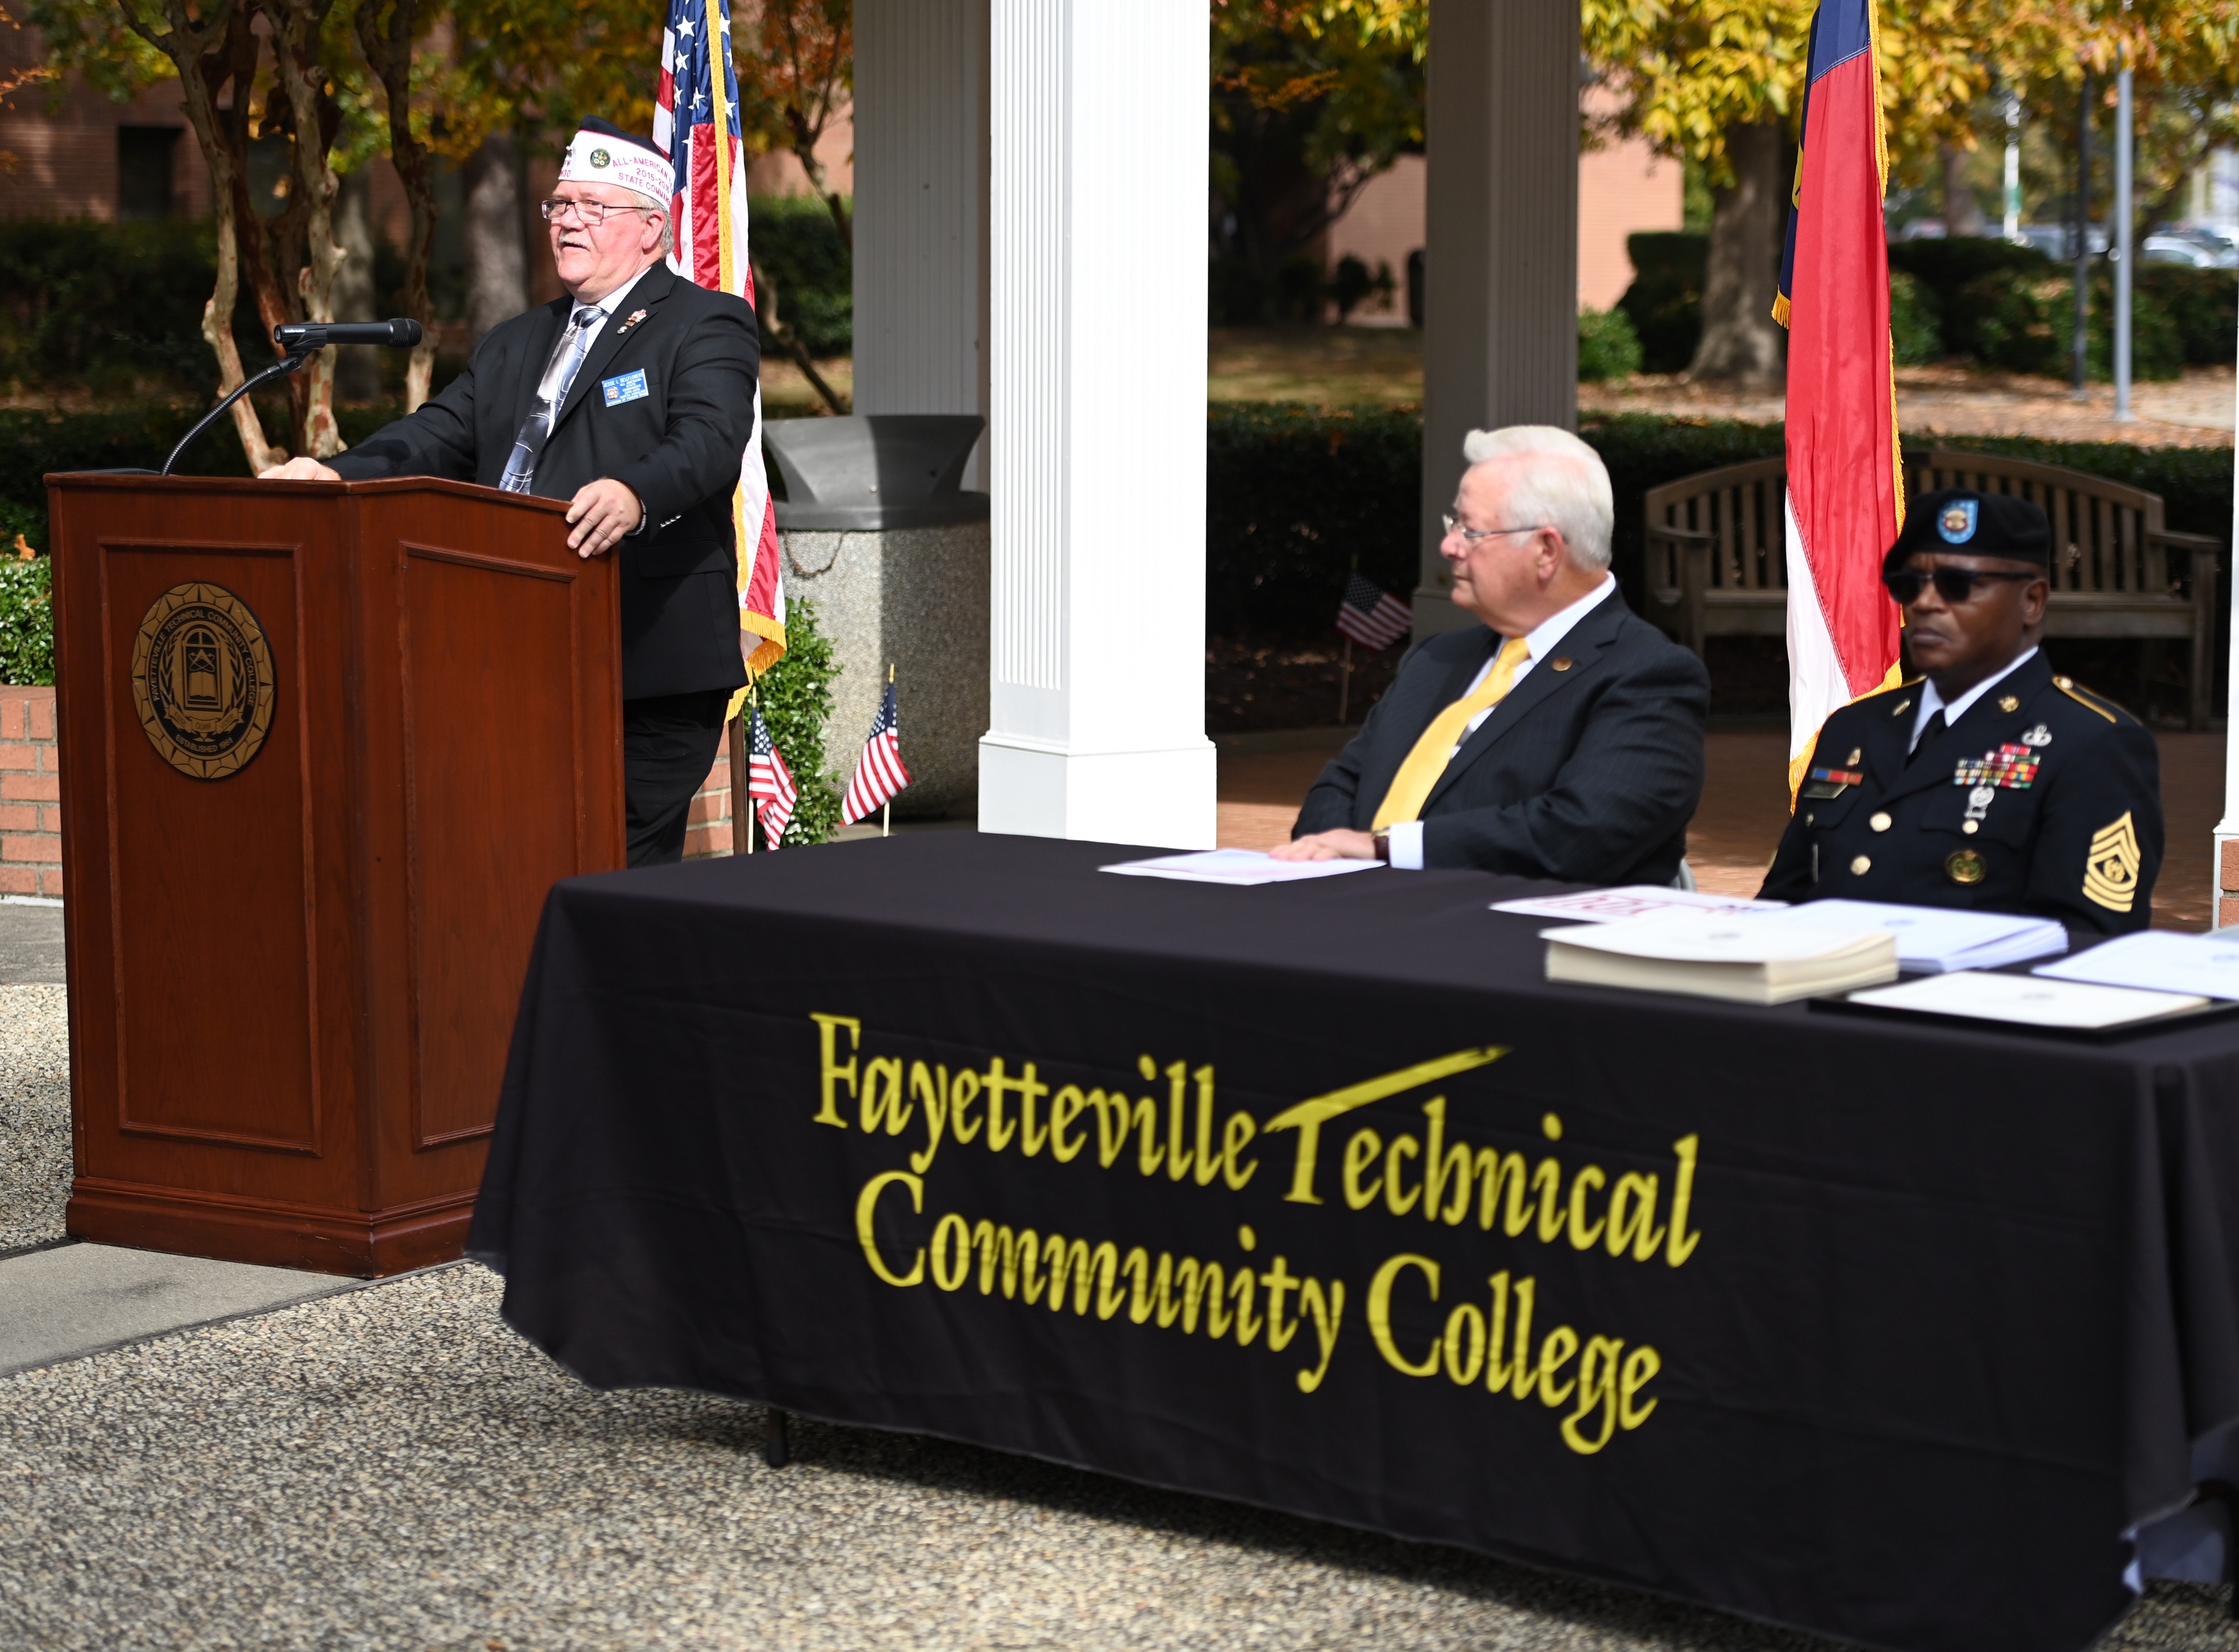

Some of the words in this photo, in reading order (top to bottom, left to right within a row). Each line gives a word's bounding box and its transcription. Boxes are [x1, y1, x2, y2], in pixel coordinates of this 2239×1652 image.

[612, 157, 668, 179] ALL-AMERICAN
[618, 172, 644, 187] STATE
[150, 632, 167, 701] FAYETTEVILLE
[165, 610, 205, 632] TECHNICAL
[207, 611, 249, 653] COMMUNITY
[246, 657, 256, 707] COLLEGE
[175, 734, 218, 753] ESTABLISHED
[810, 1012, 1259, 1191] Fayetteville
[1262, 1046, 1702, 1268] Technical
[856, 1170, 1346, 1394] Community
[1367, 1253, 1662, 1455] College
